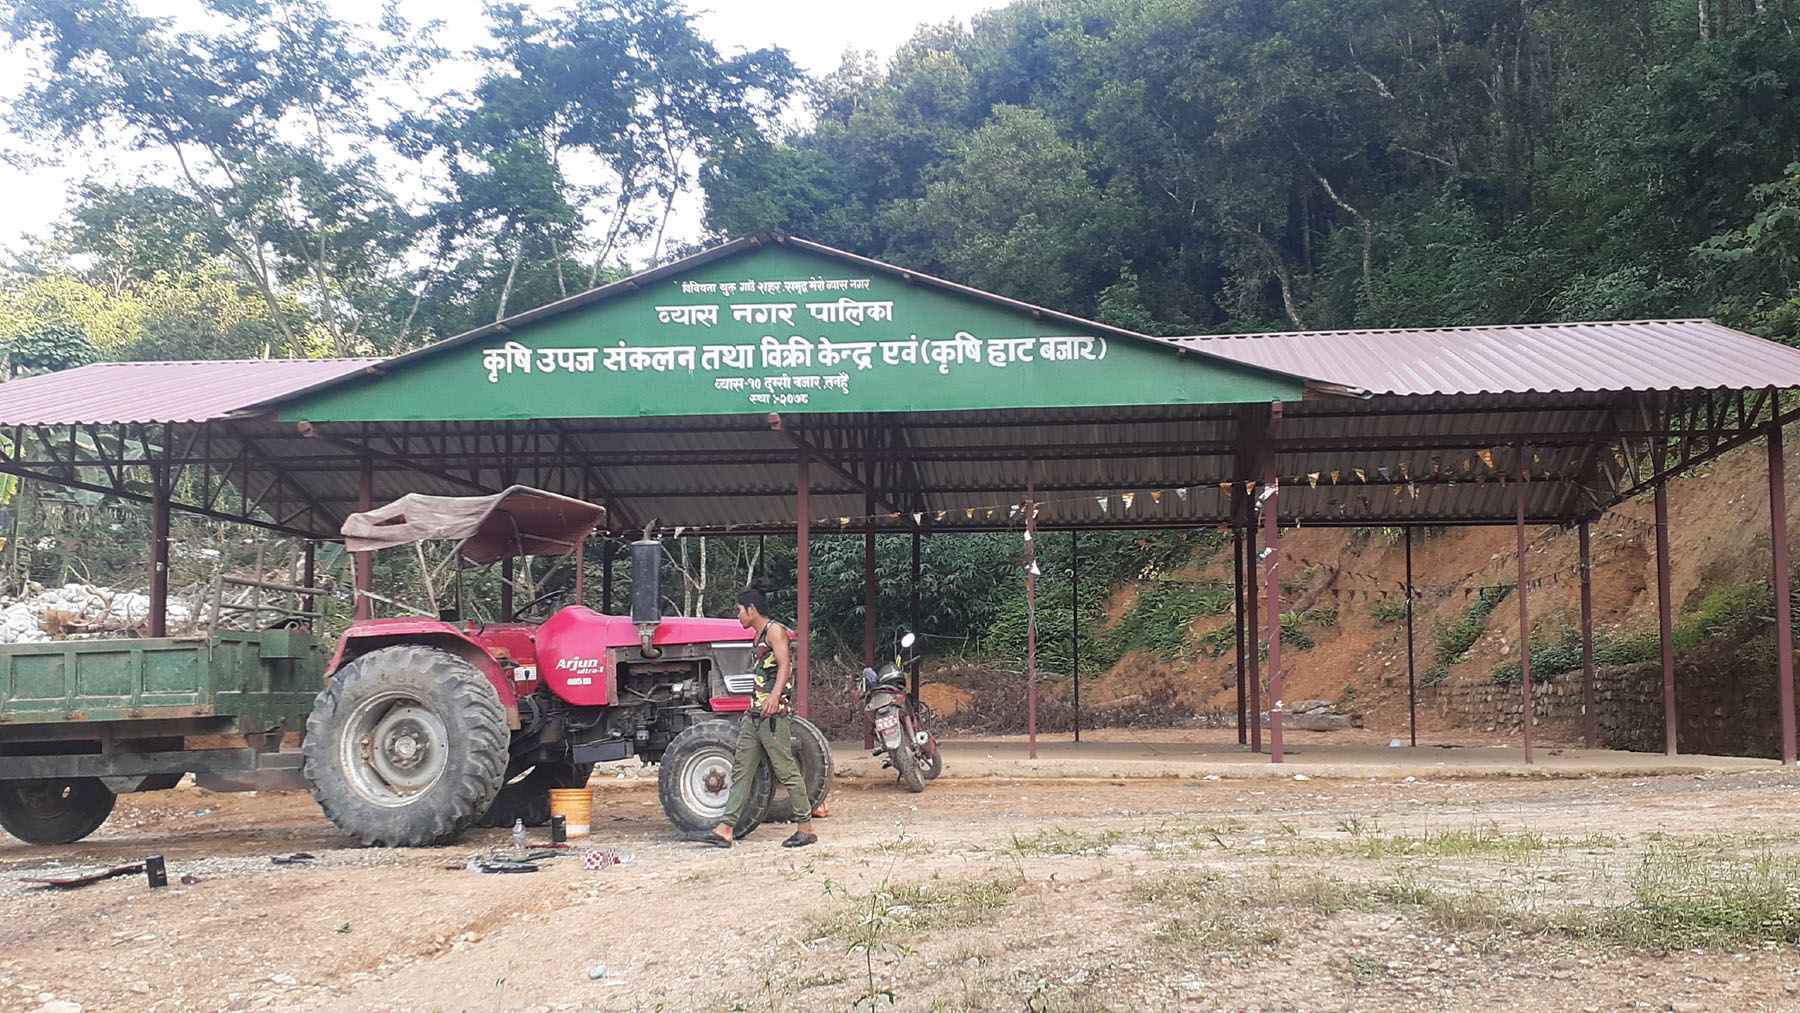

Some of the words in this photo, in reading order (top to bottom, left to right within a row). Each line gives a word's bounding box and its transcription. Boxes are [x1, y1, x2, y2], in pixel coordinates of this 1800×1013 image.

[850, 280, 870, 290] नगर
[655, 305, 719, 327] व्यास
[730, 304, 797, 326] नगर
[806, 298, 893, 326] पालिका
[483, 342, 532, 382] कृषि
[536, 348, 598, 372] उपज
[603, 341, 696, 373] संकलन
[702, 345, 755, 370] तथा
[818, 337, 877, 370] केन्द्र
[879, 335, 918, 365] एवं
[987, 338, 1036, 367] हाट
[1040, 337, 1106, 360] बजार)
[555, 656, 598, 671] Arjun
